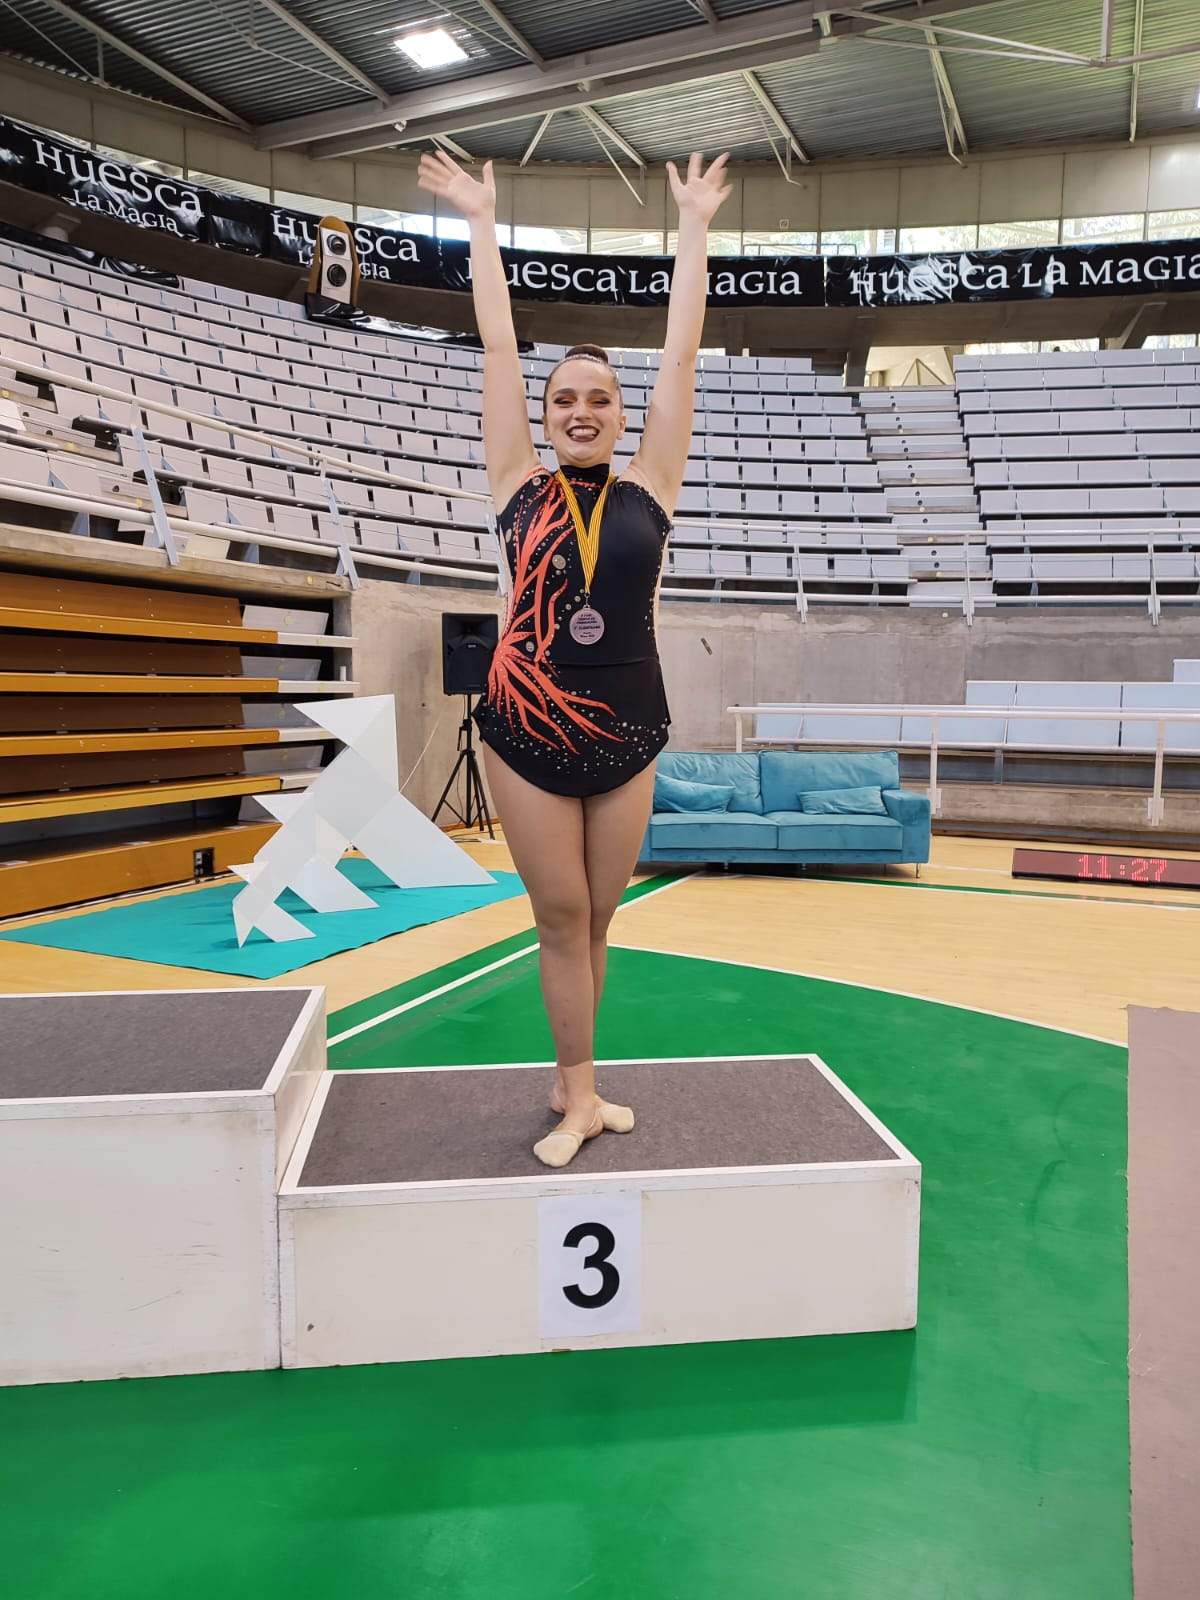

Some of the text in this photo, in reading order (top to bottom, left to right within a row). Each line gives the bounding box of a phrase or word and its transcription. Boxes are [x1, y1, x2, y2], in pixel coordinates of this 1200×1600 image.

[270, 212, 421, 263] Husca
[1077, 854, 1168, 882] 11:27
[562, 1221, 620, 1309] 3
